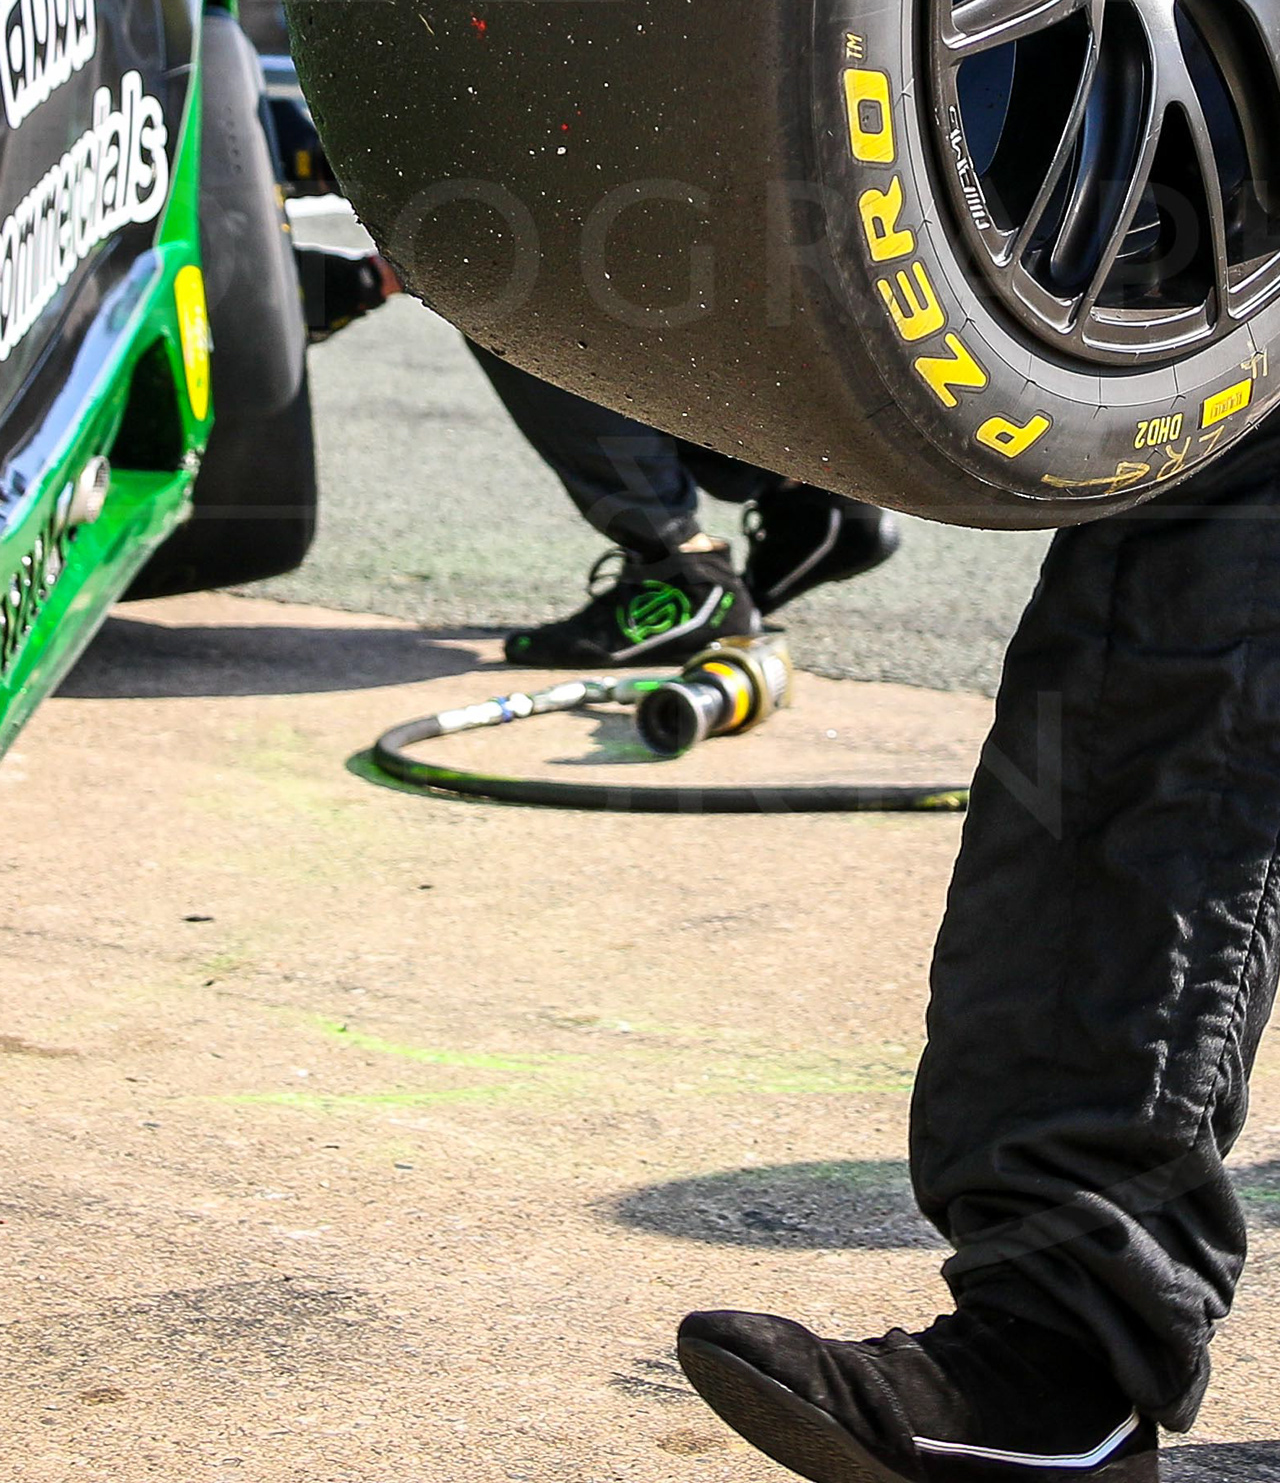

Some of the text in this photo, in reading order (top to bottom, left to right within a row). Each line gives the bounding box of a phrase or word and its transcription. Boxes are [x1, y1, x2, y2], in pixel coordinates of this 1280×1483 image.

[842, 67, 990, 409] ZERO
[976, 410, 1051, 459] P
[1133, 412, 1184, 450] DHD2
